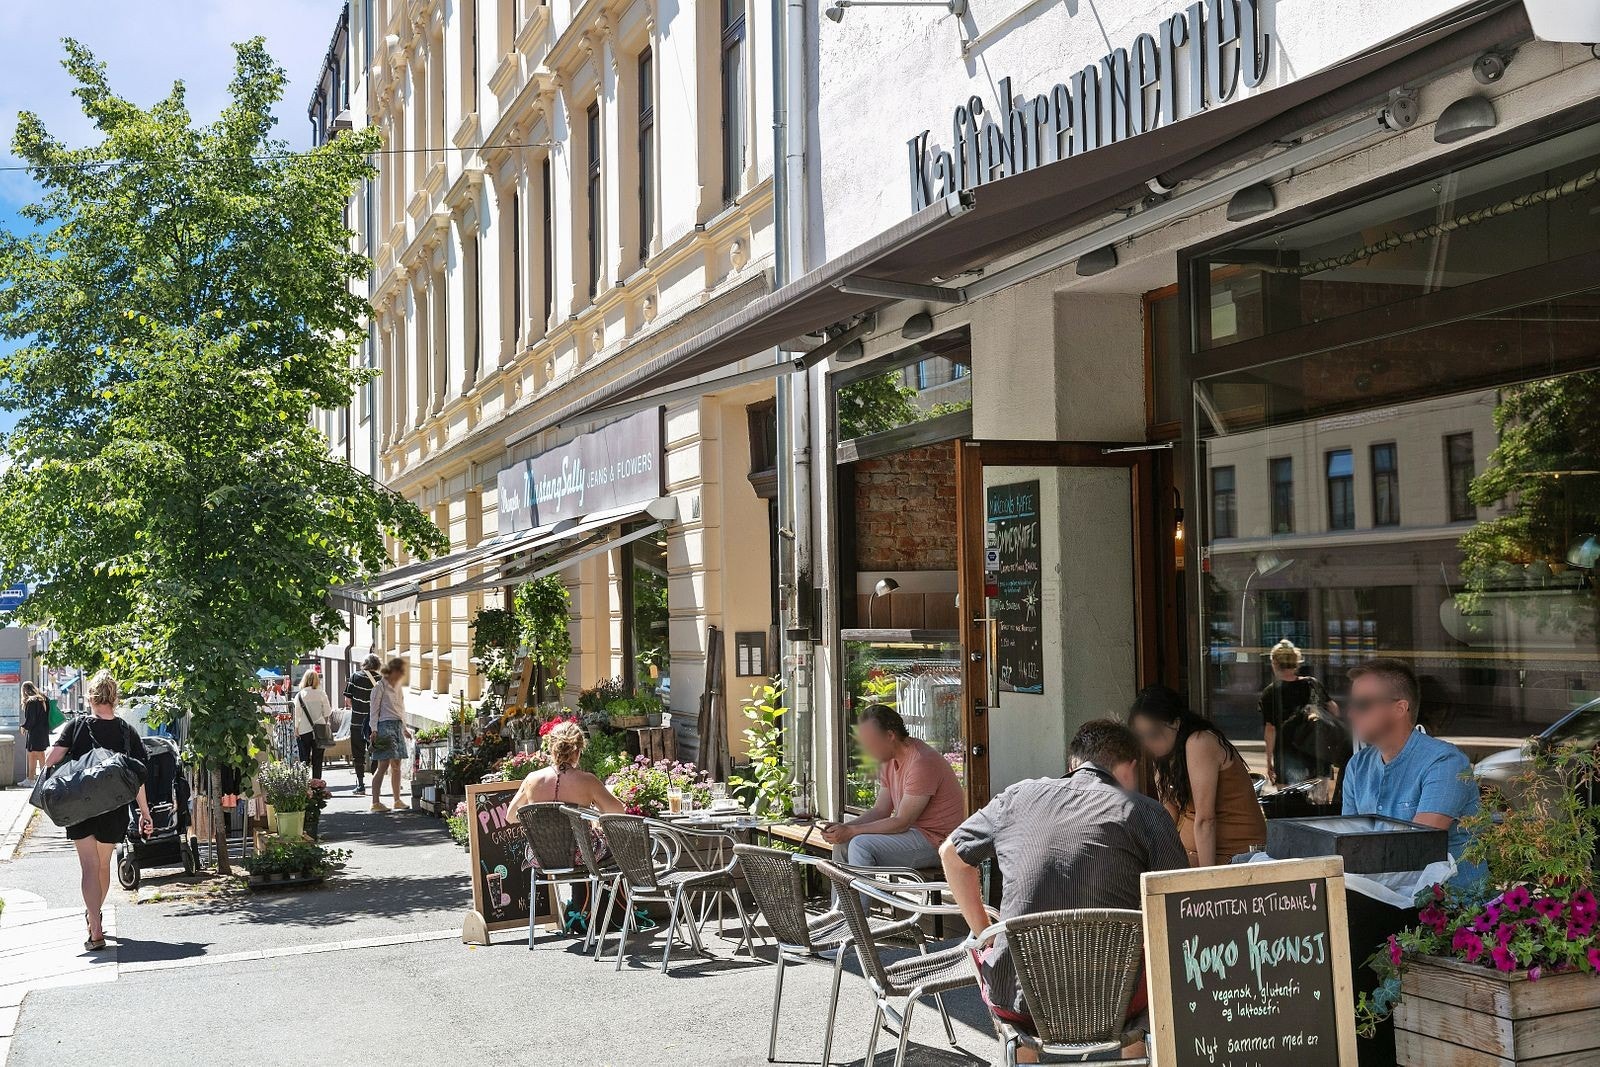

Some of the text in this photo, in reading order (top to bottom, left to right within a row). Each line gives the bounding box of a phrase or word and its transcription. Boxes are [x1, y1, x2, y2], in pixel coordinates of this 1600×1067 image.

[907, 0, 1270, 213] Kaffebrenneriet
[586, 467, 607, 489] JEANS
[610, 466, 615, 482] &
[617, 452, 652, 480] FLOWERS
[895, 676, 926, 718] Kaffe
[478, 803, 508, 834] PIN
[1180, 897, 1248, 919] FAVORITTEN
[1252, 897, 1267, 916] ER
[1182, 935, 1239, 991] KOKO
[1261, 978, 1300, 1004] glutenfri
[1222, 1001, 1281, 1021] og laktosefri
[1194, 1031, 1319, 1063] Nyt sammen med en
